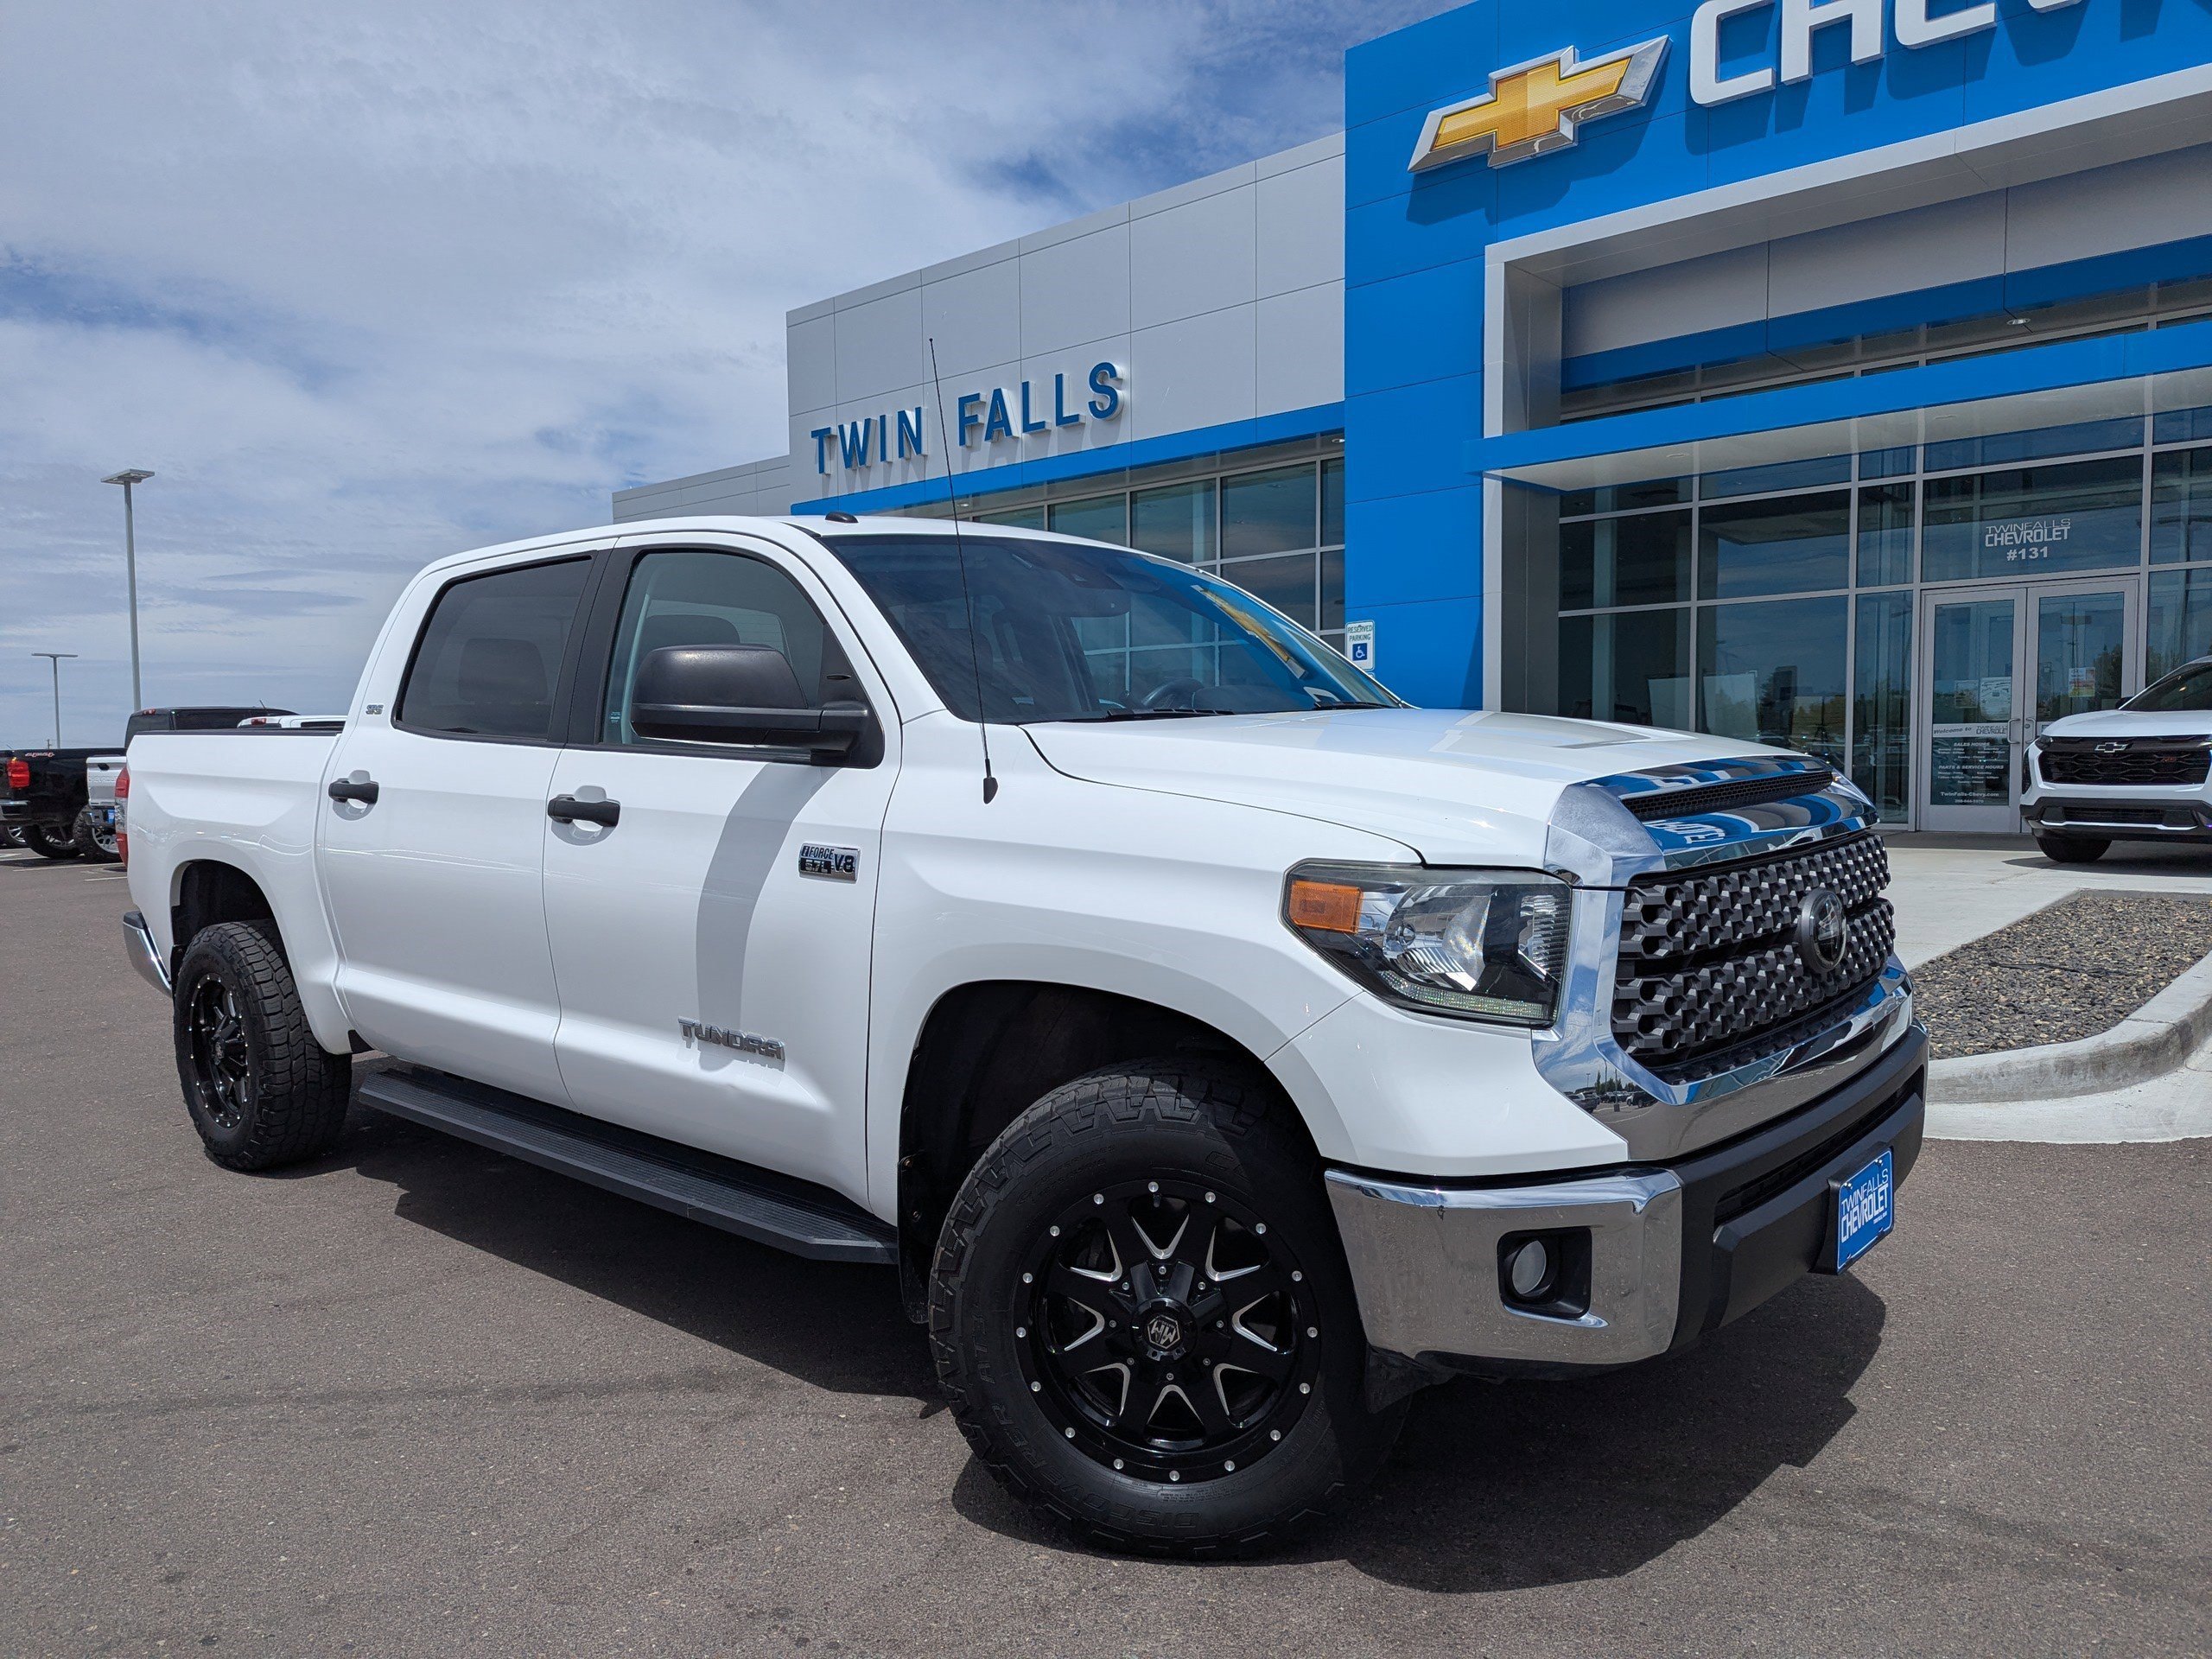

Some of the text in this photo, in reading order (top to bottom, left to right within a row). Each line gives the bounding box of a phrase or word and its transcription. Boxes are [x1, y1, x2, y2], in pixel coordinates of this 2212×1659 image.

[1690, 0, 2081, 107] CH
[810, 361, 1122, 474] TWIN FALLS
[1985, 526, 2071, 547] CHEVROLET
[2006, 546, 2049, 561] #131
[1348, 625, 1373, 633] RESERVED
[834, 854, 855, 874] V8
[678, 1016, 785, 1060] TUNDRA
[1840, 1182, 1889, 1243] CHEVROLET
